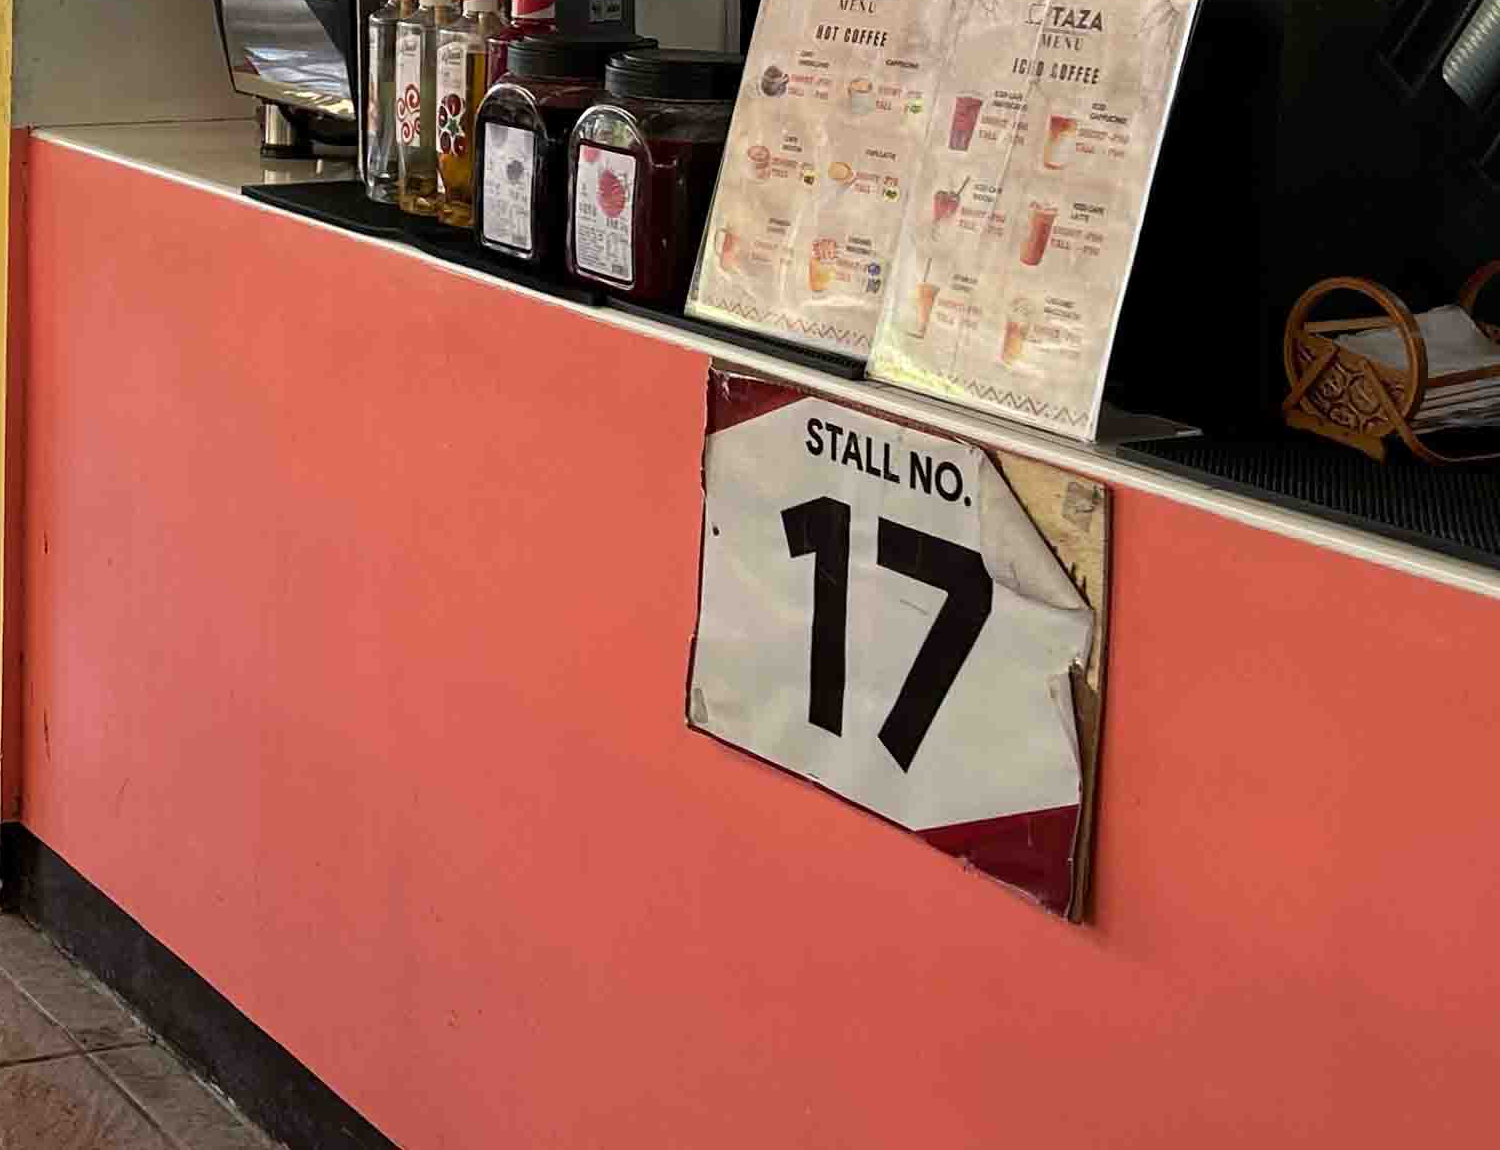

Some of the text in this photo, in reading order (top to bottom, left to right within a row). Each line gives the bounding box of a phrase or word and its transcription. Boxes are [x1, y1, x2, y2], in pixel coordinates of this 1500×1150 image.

[1052, 6, 1104, 32] TAZA
[815, 24, 889, 48] HOT COFFEE
[1040, 33, 1084, 51] MENU
[1051, 62, 1101, 85] COFFEE
[805, 417, 973, 508] STALL NO.
[779, 494, 995, 775] 17
